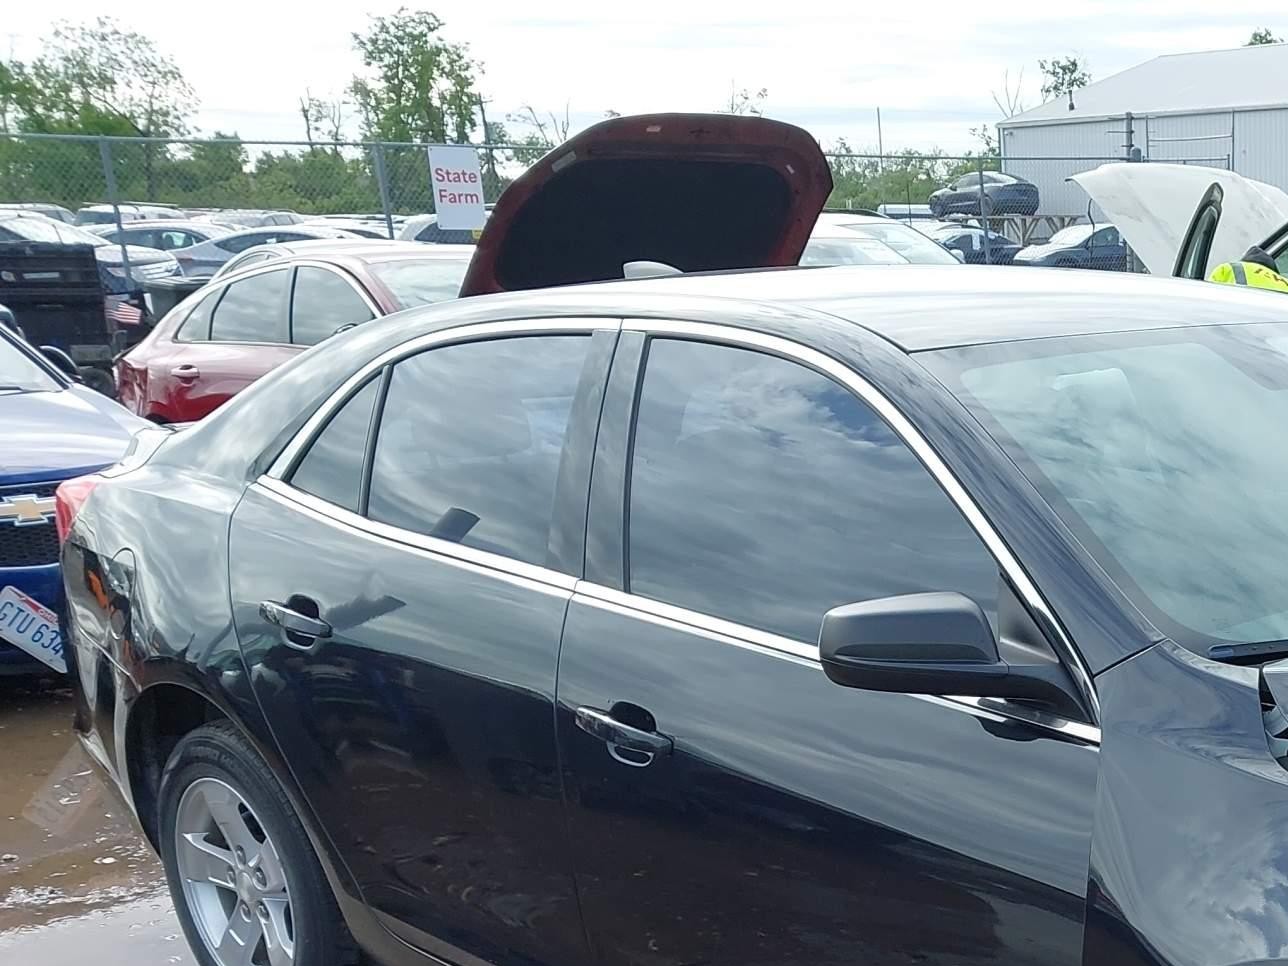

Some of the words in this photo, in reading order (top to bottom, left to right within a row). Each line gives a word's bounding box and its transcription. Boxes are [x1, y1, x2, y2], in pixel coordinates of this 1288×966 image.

[435, 168, 477, 183] State
[439, 189, 479, 203] Farm
[31, 623, 64, 659] 634
